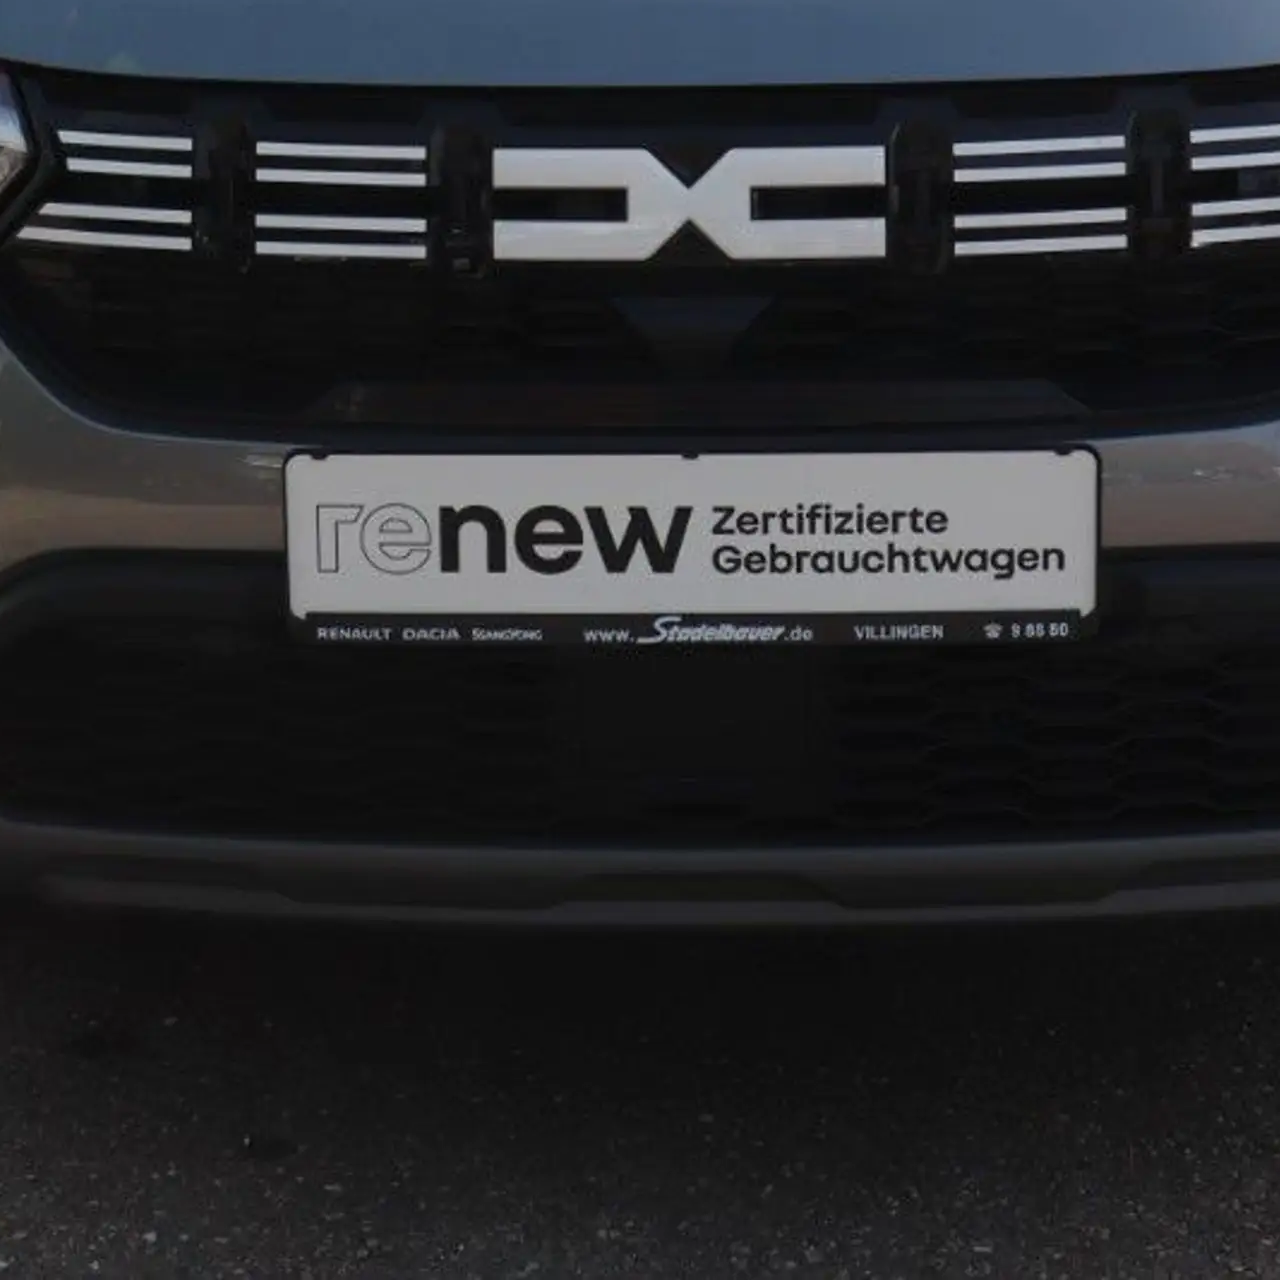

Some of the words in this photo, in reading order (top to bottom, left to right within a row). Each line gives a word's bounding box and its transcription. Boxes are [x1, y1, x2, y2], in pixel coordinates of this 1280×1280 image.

[316, 502, 694, 576] renew
[712, 503, 949, 536] Zertifizierte
[712, 543, 1065, 581] Gebrauchtwagen
[317, 627, 392, 641] RENAULT
[402, 627, 461, 641] DACIA
[854, 625, 944, 640] VILLINGEN
